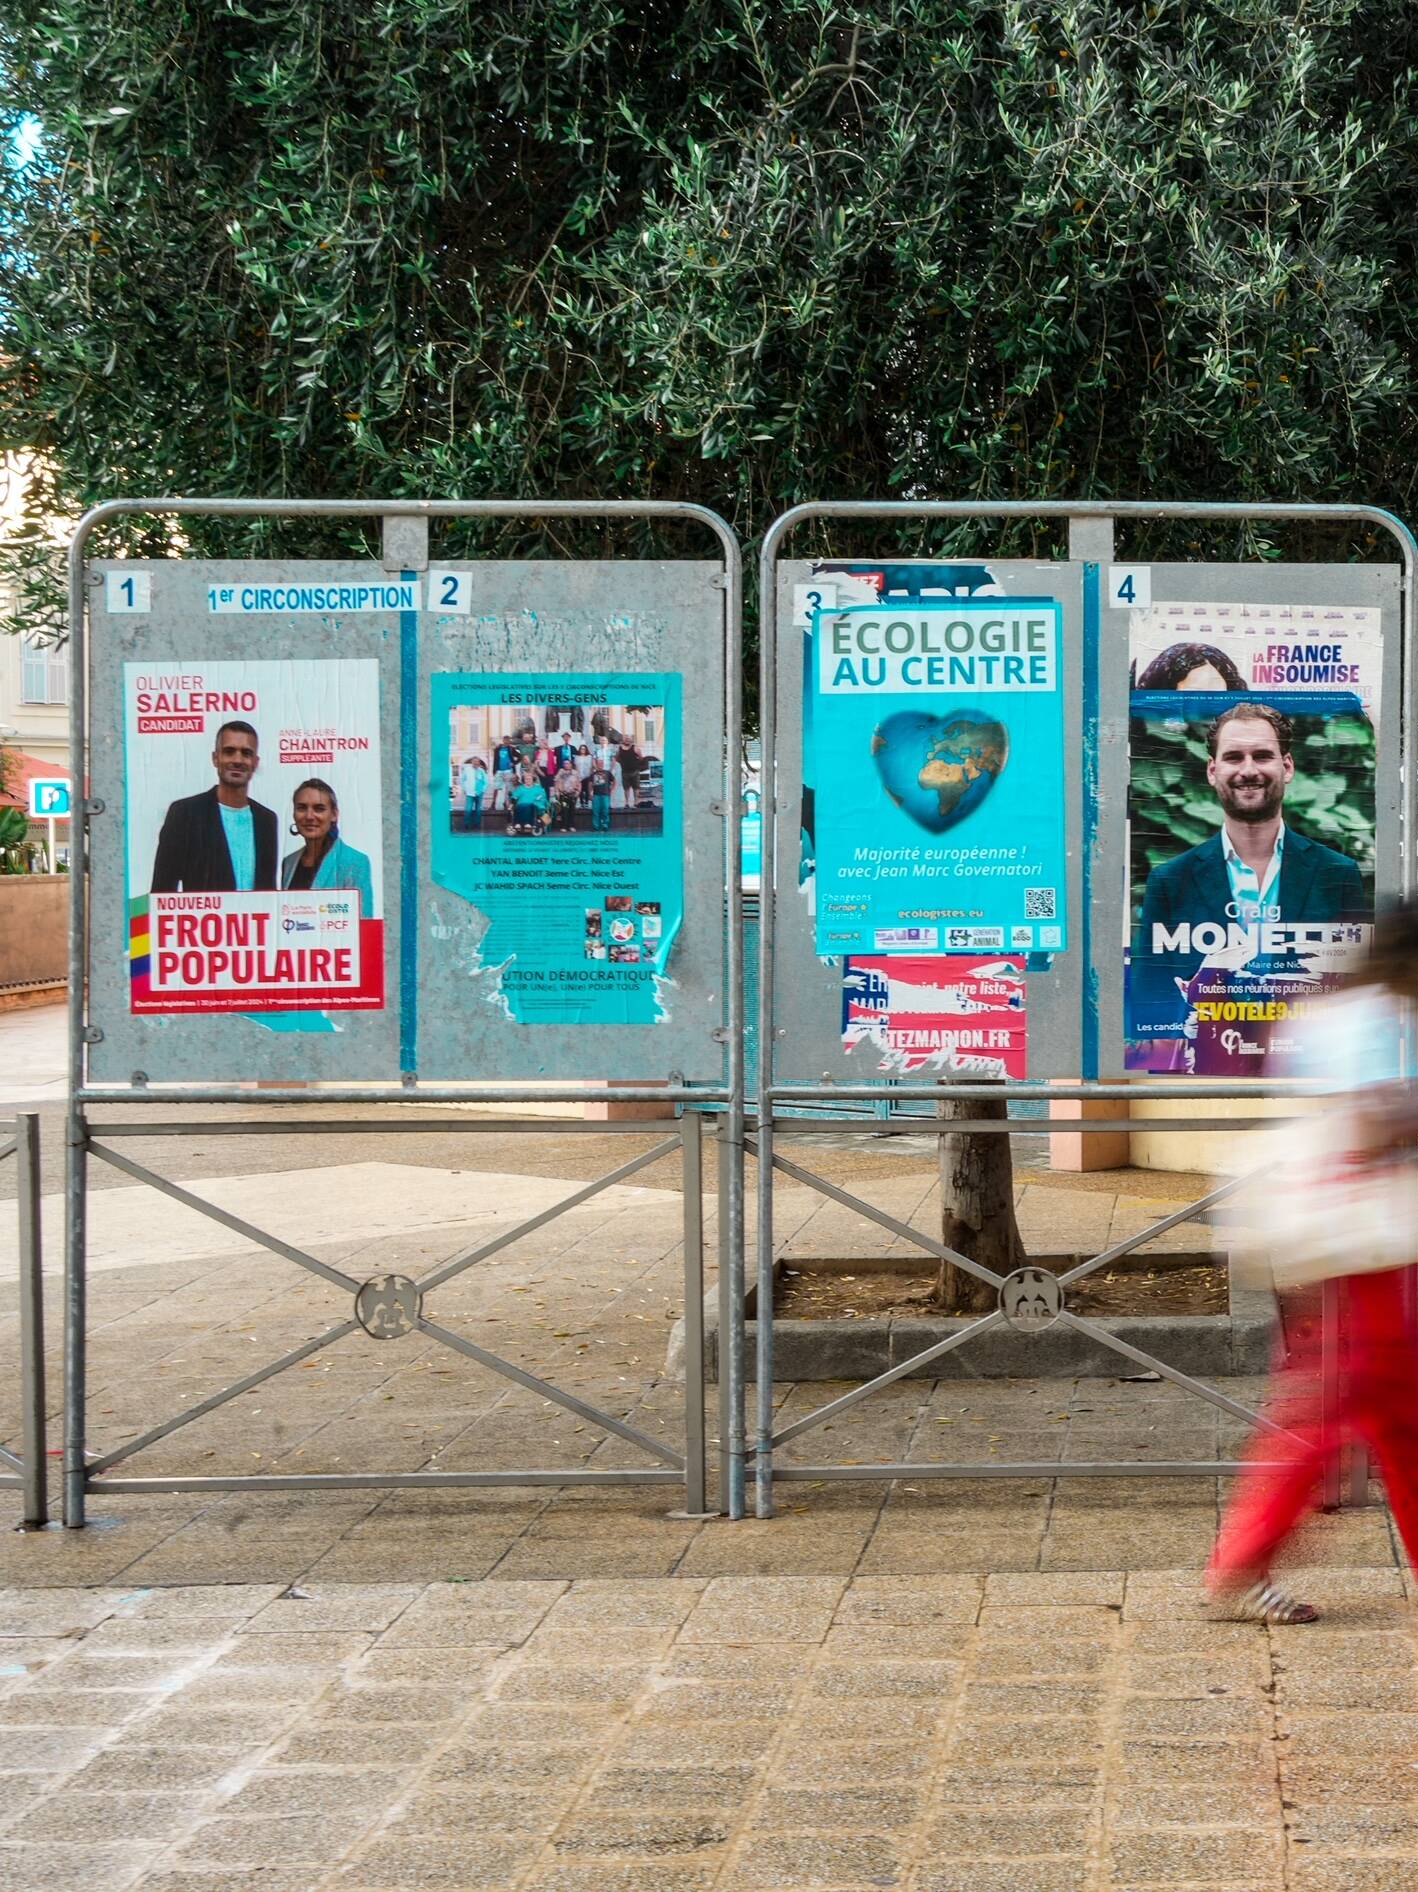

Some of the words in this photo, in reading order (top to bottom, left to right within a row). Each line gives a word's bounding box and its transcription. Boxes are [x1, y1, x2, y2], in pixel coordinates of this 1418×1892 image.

[120, 577, 134, 607] 1
[241, 586, 413, 609] CIRCONSCRIPTION
[440, 576, 459, 606] 2
[1117, 575, 1136, 603] 4
[805, 591, 821, 620] 3
[832, 613, 1046, 654] ÉCOLOGIE
[1253, 653, 1264, 663] LA
[1266, 645, 1342, 663] FRANCE
[832, 656, 887, 686] AU
[901, 655, 1048, 685] CENTRE
[1252, 665, 1360, 683] INSOUMISE
[136, 675, 204, 691] OLIVIER
[137, 691, 257, 713] SALERNO
[501, 693, 522, 704] LES
[526, 693, 607, 704] DIVERS-GENS
[140, 718, 202, 732] CANDIDAT
[279, 738, 369, 751] CHAINTRON
[473, 857, 514, 866] CHANTAL
[591, 857, 611, 865] Nice
[612, 857, 642, 865] Centre
[854, 847, 920, 862] Majorité
[925, 846, 1018, 862] européenne
[1021, 846, 1027, 858] !
[591, 869, 611, 878] Nice
[838, 867, 872, 878] avec
[873, 865, 908, 880] Jean
[912, 864, 949, 877] Marc
[953, 863, 1043, 876] Governatori
[592, 882, 611, 890] Nice
[613, 882, 639, 890] Ouest
[157, 896, 222, 911] NOUVEAU
[1224, 902, 1281, 923] Craig
[157, 912, 271, 949] FRONT
[159, 948, 352, 986] POPULAIRE
[1247, 961, 1271, 969] Maire
[1273, 961, 1286, 969] de
[616, 983, 640, 991] TOUS
[1197, 983, 1227, 994] Toutes
[1227, 985, 1244, 994] nos
[1245, 984, 1282, 994] réunions
[1283, 983, 1323, 997] publiques
[1137, 1023, 1152, 1032] Les
[1153, 1023, 1184, 1032] candid
